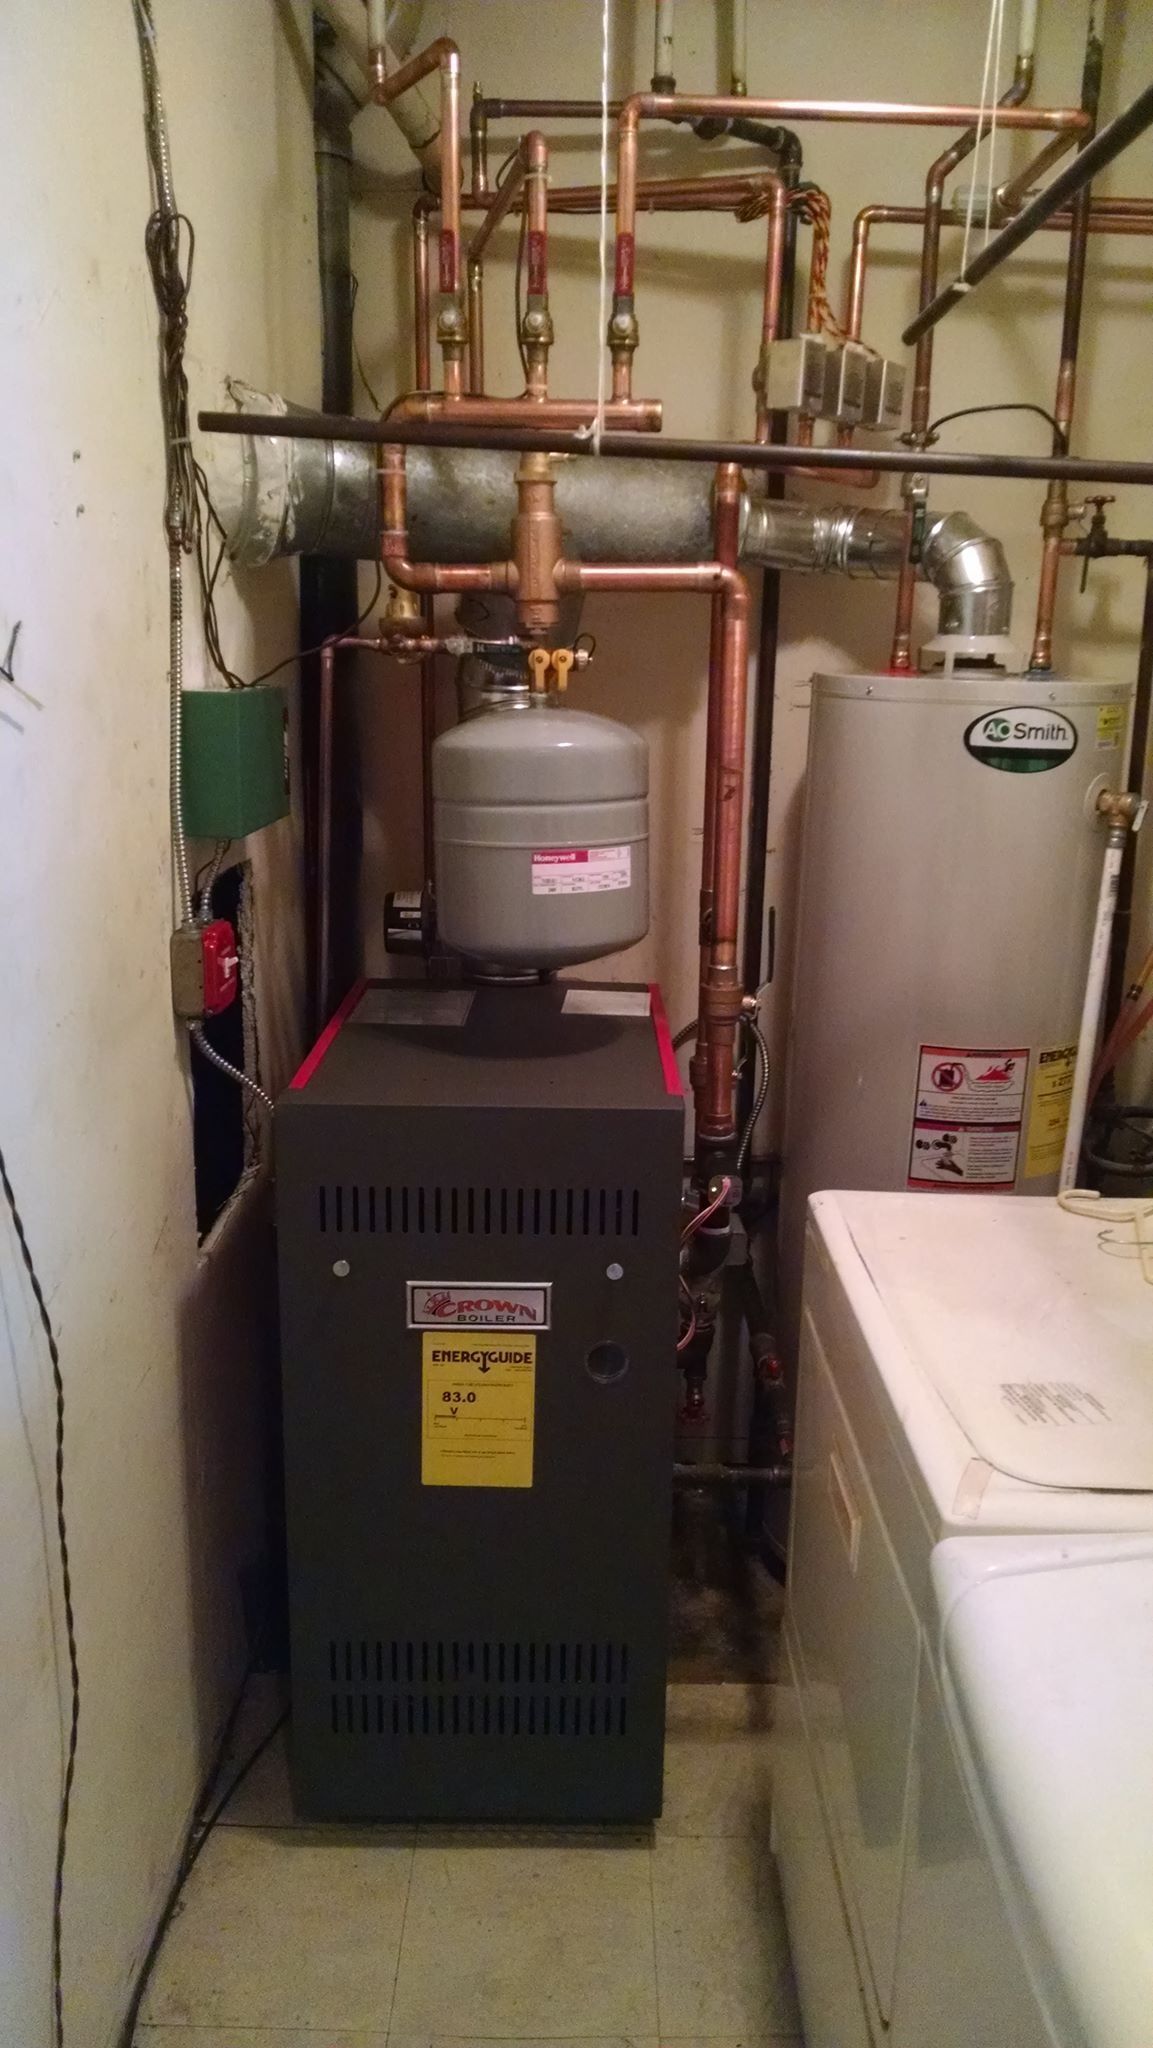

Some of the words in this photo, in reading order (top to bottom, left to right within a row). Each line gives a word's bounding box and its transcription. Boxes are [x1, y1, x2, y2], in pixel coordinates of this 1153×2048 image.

[1014, 722, 1066, 741] Smith
[533, 853, 576, 863] Honeywell
[436, 1298, 537, 1321] CROWN
[457, 1314, 516, 1322] BOILER
[432, 1350, 533, 1367] ENERGYGUIDE
[442, 1391, 476, 1403] 83.0
